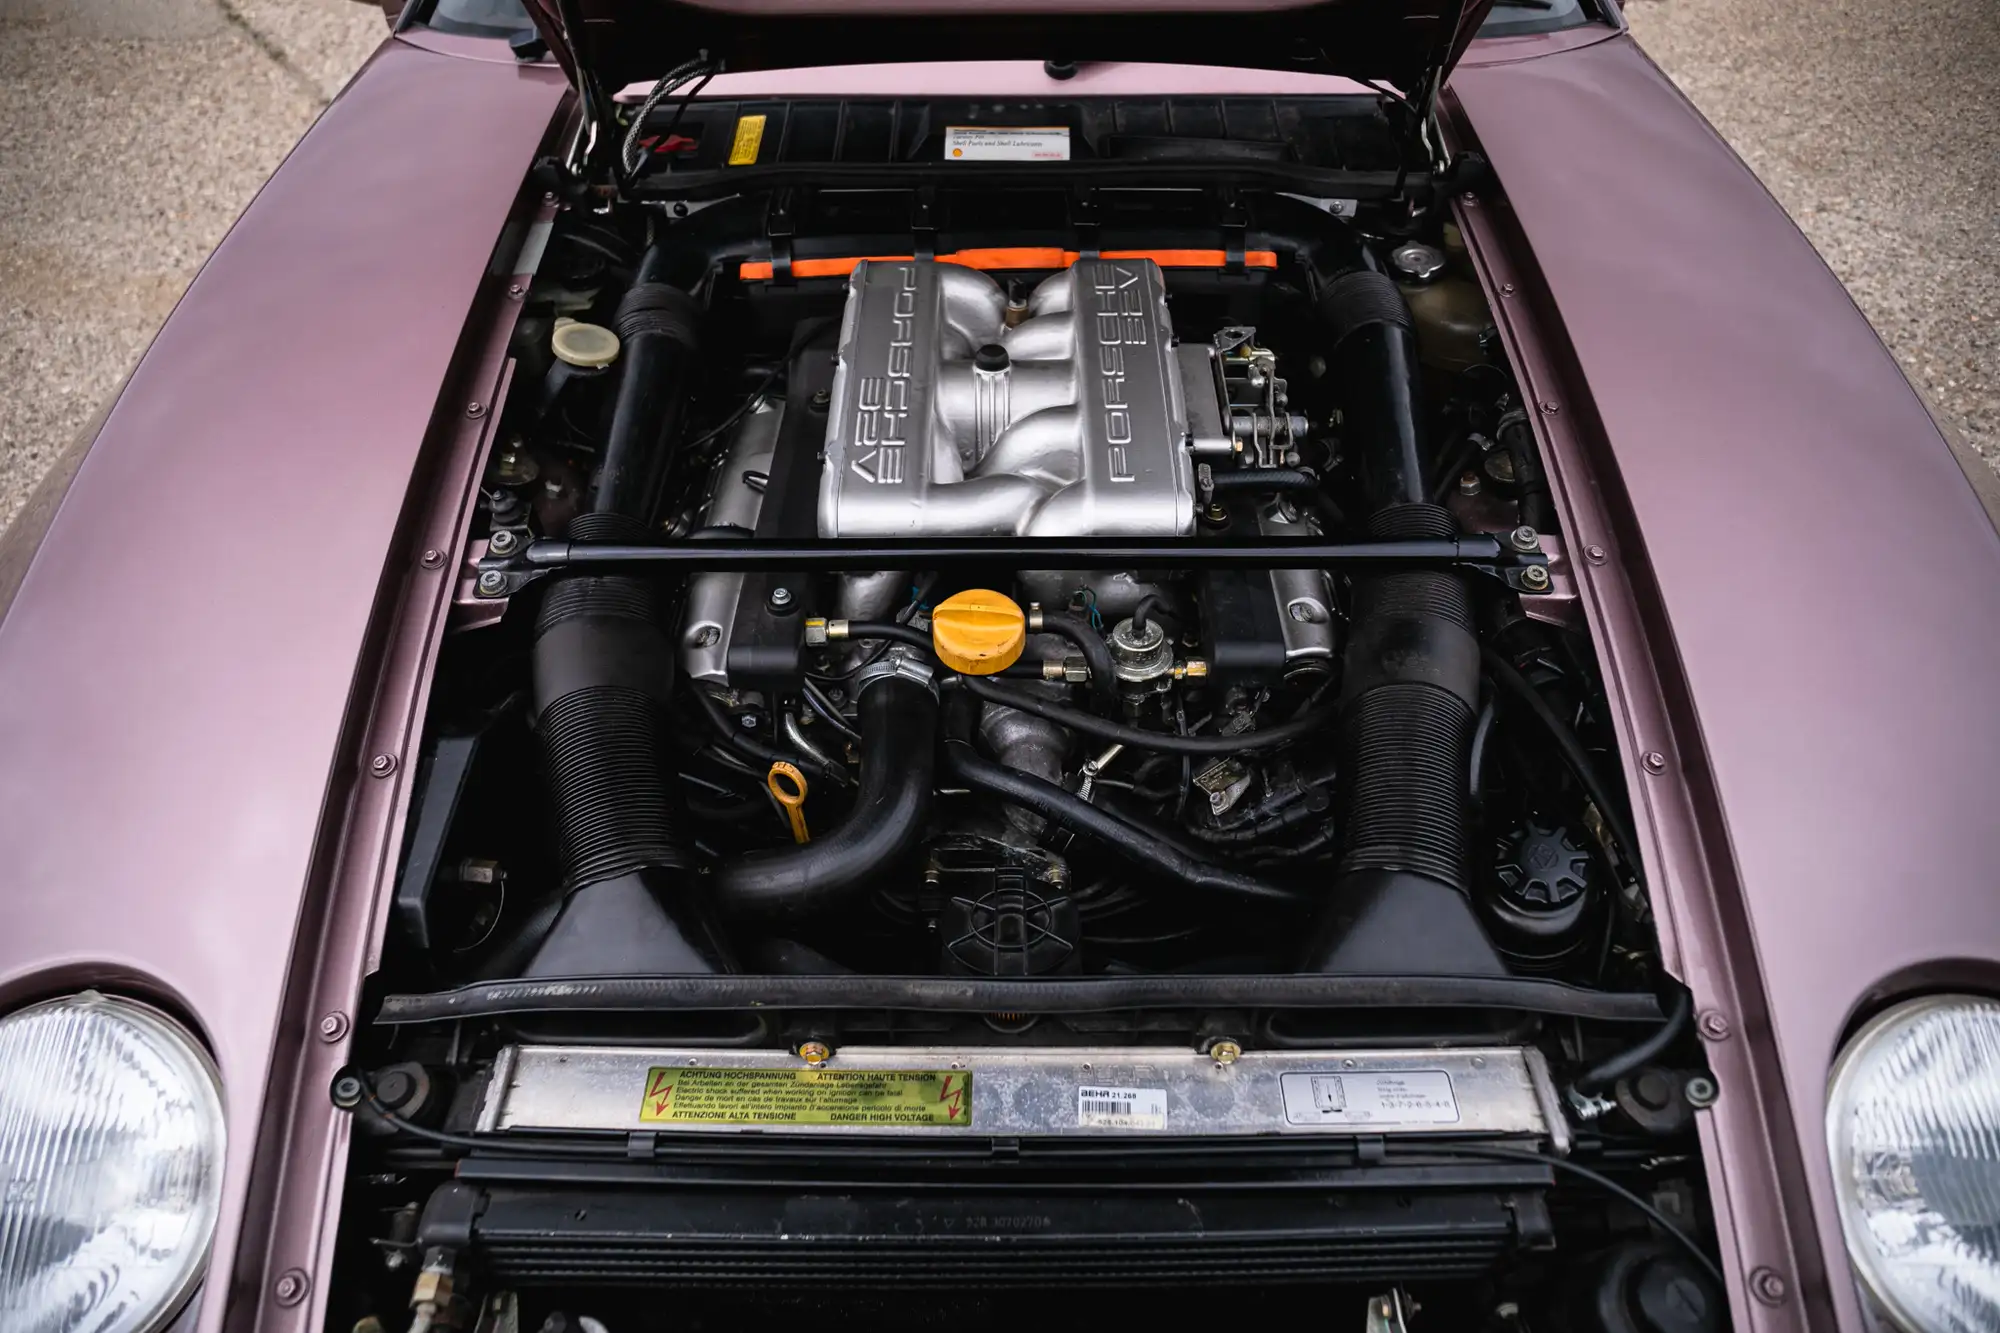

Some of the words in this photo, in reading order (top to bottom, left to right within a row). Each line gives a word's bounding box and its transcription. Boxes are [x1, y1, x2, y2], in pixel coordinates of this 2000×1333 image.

[1115, 267, 1147, 346] 32V
[877, 266, 918, 485] PORSCHE
[1095, 265, 1136, 483] PORSCHE
[851, 377, 884, 484] 32V
[679, 1070, 722, 1080] ACHTUNG
[723, 1071, 796, 1081] HOCHSPANNUNG
[817, 1073, 865, 1082] ATTENTION
[867, 1073, 896, 1082] HAUTE
[898, 1073, 937, 1082] TENSION
[676, 1086, 704, 1094] Electric
[706, 1087, 728, 1095] shock
[730, 1087, 761, 1095] suffered
[785, 1089, 815, 1098] working
[1080, 1089, 1110, 1098] BEHR
[675, 1094, 703, 1103] Danger
[894, 1104, 902, 1112] di
[672, 1110, 726, 1120] ATTENZIONE
[728, 1111, 751, 1120] ALTA
[753, 1112, 796, 1121] TENSIONE
[830, 1113, 868, 1122] DANGER
[870, 1113, 893, 1122] HIGH
[895, 1113, 934, 1122] VOLTAGE
